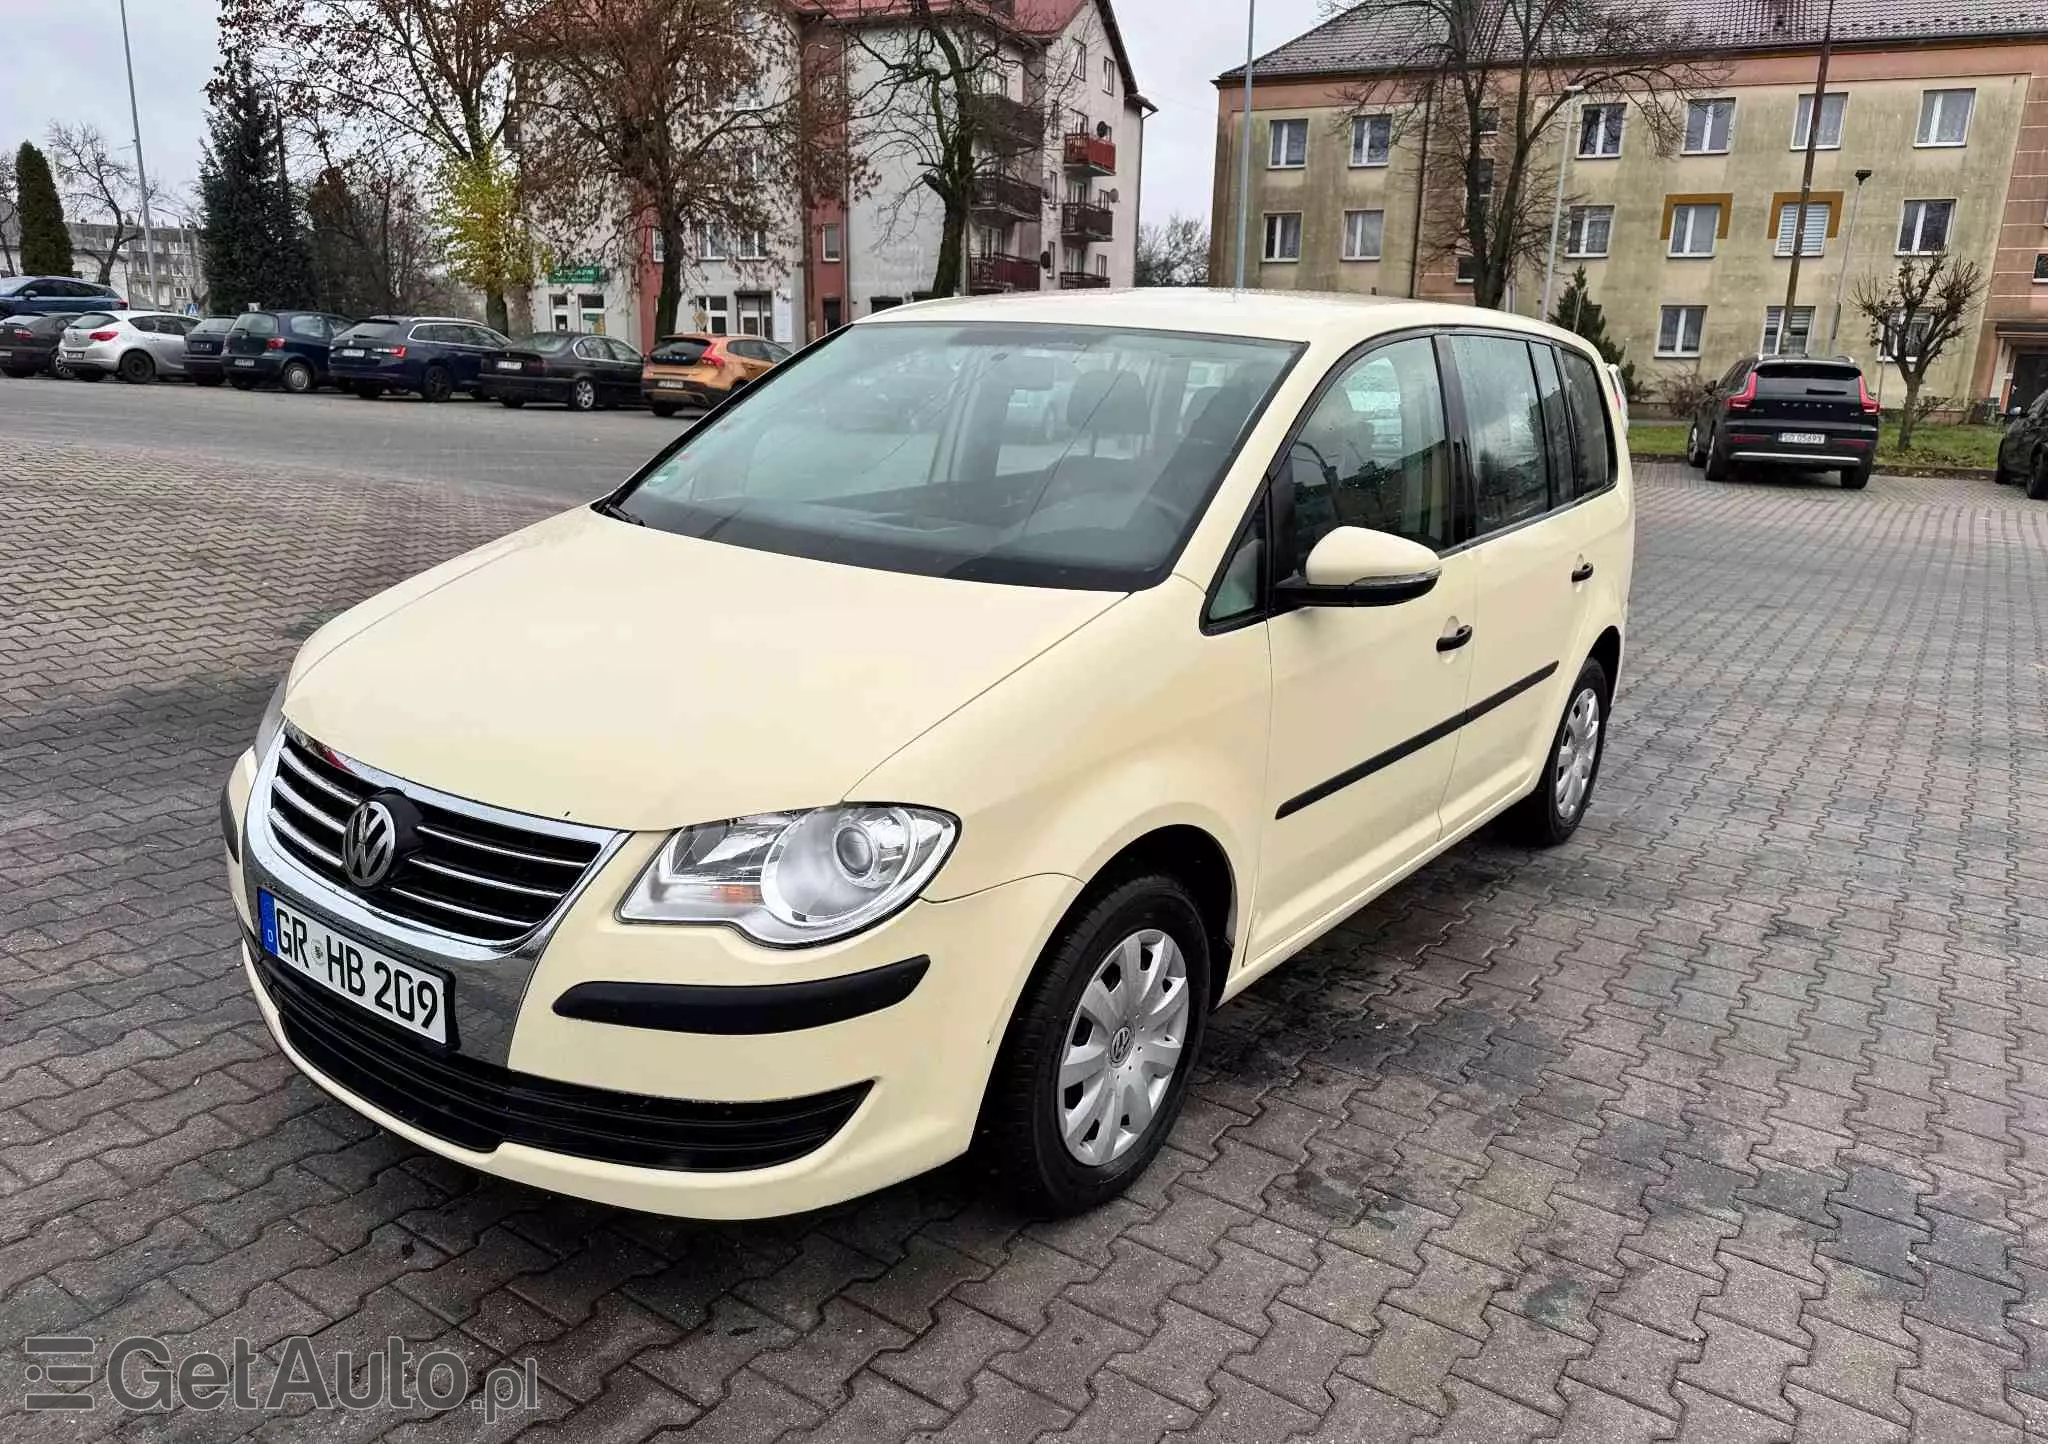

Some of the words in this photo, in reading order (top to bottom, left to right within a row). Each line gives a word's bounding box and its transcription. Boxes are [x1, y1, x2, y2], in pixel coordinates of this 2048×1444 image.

[267, 929, 273, 943] D
[276, 908, 310, 969] GR
[326, 934, 365, 997] HB
[374, 960, 438, 1029] 209
